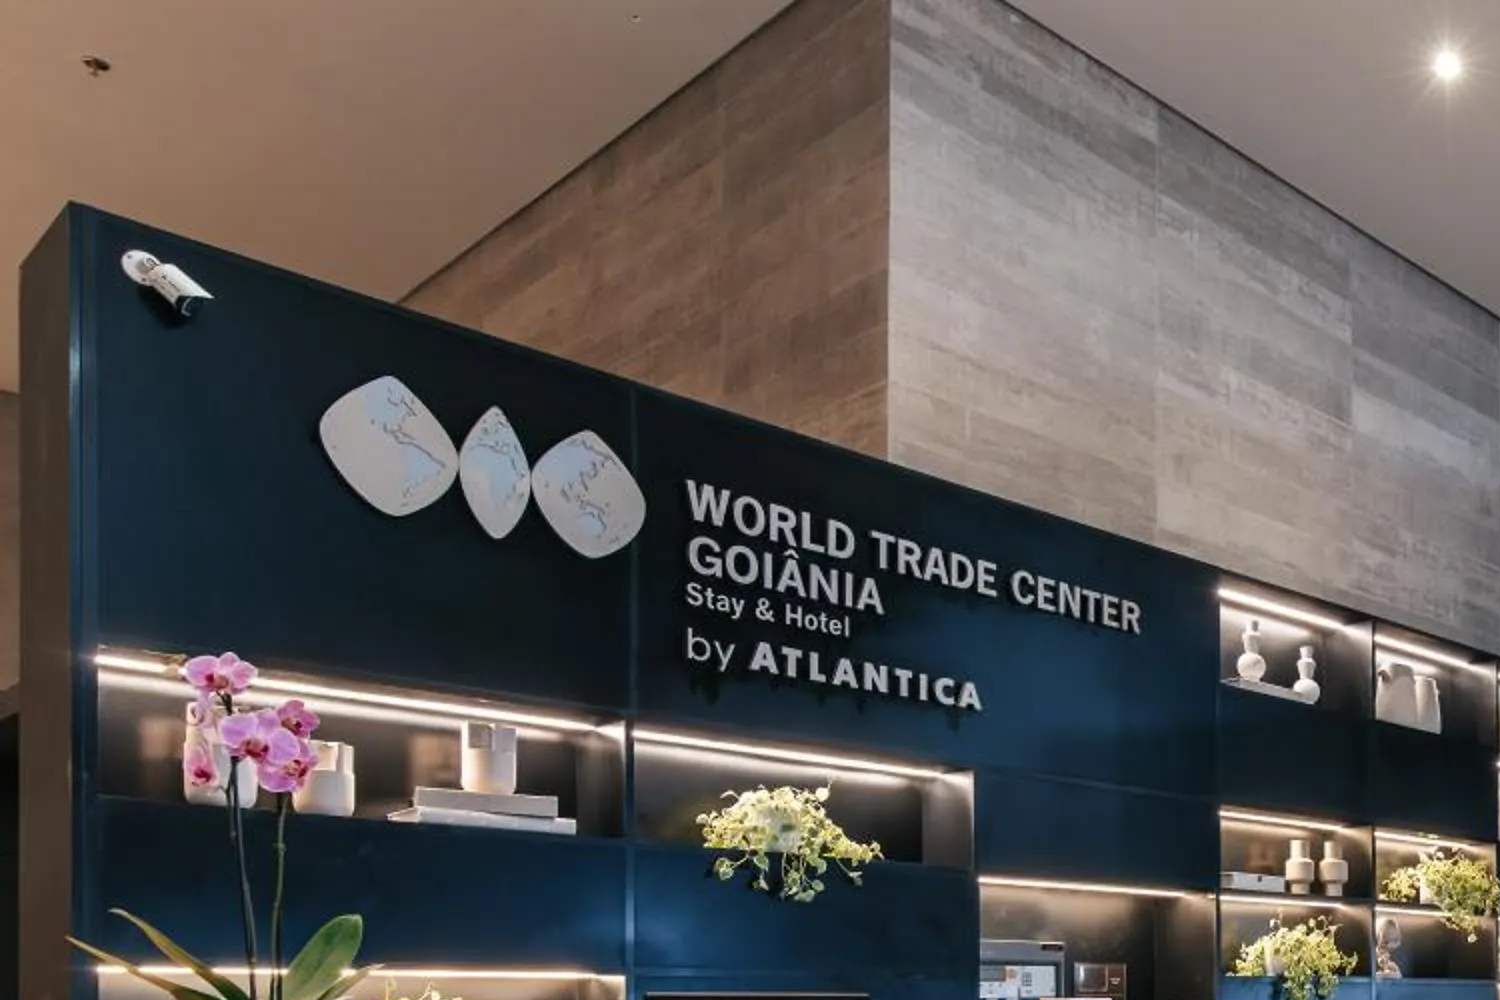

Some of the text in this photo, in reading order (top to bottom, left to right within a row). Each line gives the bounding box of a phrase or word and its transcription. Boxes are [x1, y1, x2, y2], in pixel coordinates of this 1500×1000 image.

[686, 479, 1142, 635] WORLD TRADE CENTER
[688, 535, 886, 616] GOIÂNIA
[686, 581, 850, 638] Stay & Hotel
[686, 627, 983, 712] by ATLANTICA
